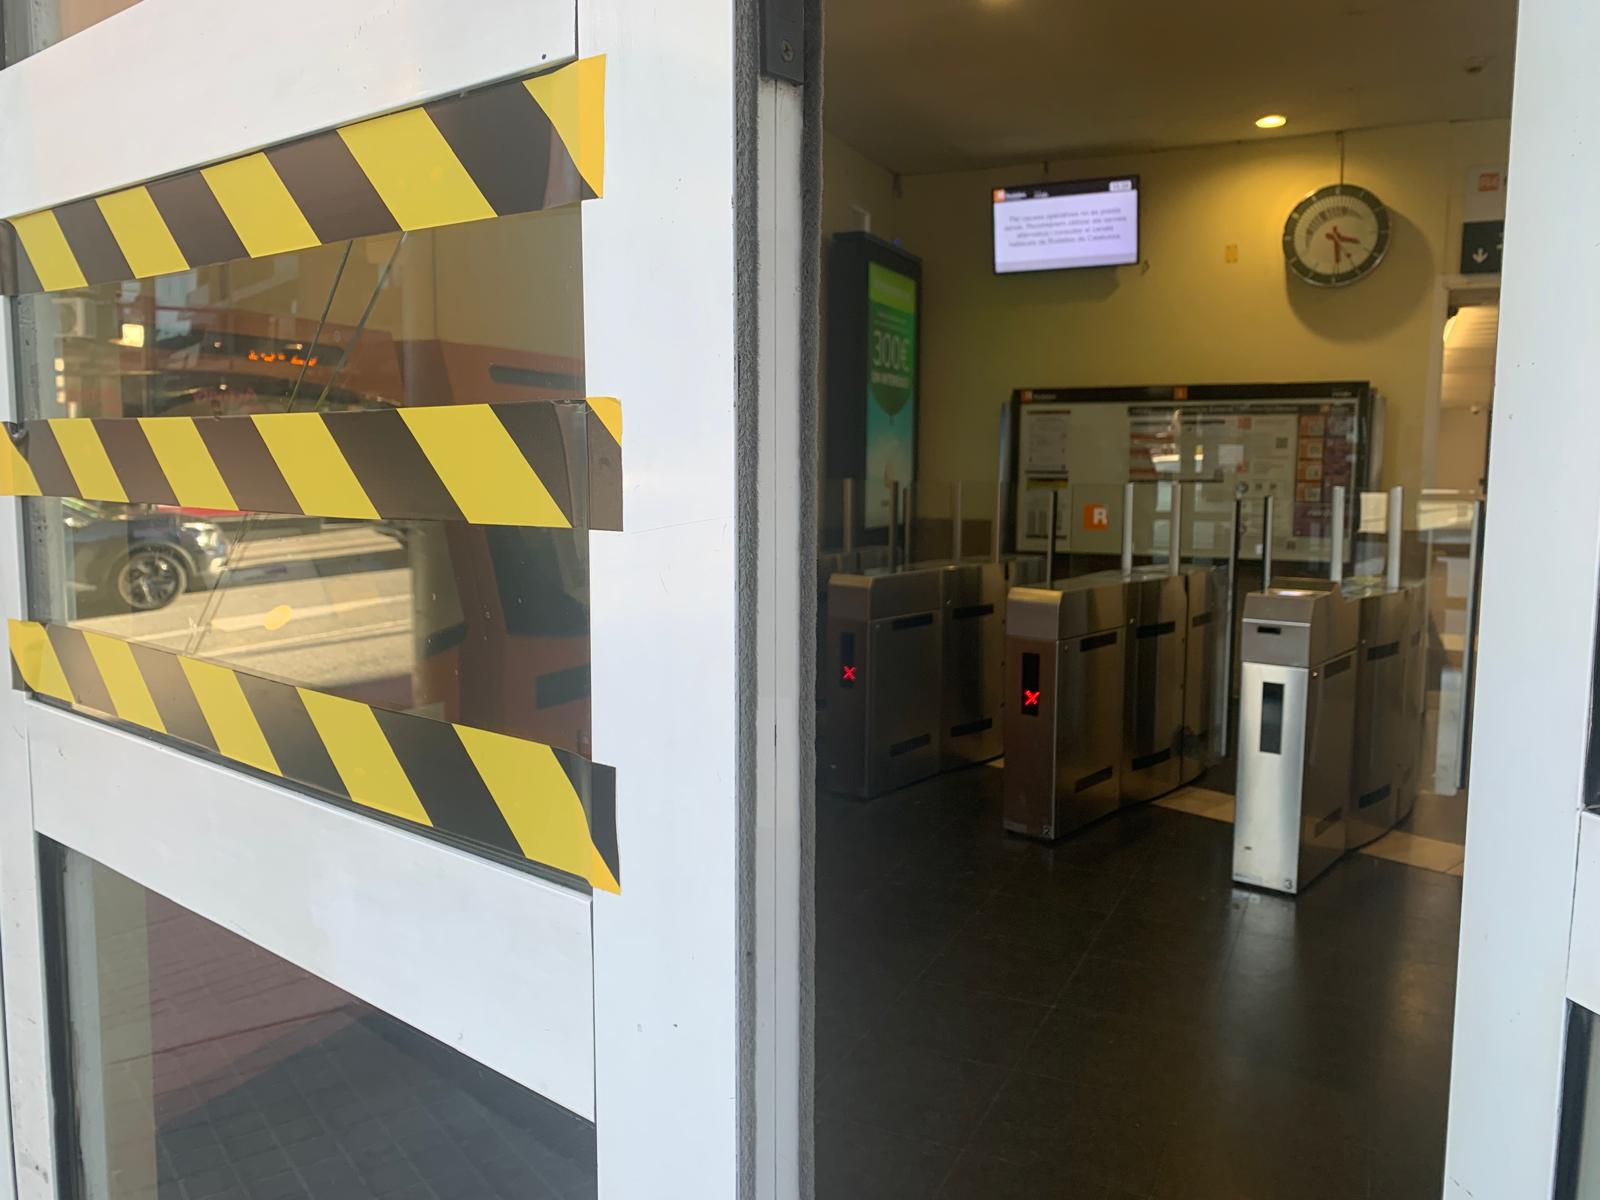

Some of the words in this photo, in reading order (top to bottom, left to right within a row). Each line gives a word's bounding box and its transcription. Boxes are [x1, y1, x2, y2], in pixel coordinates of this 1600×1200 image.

[872, 330, 910, 372] 300€
[1093, 508, 1108, 526] R
[1284, 878, 1294, 890] 3
